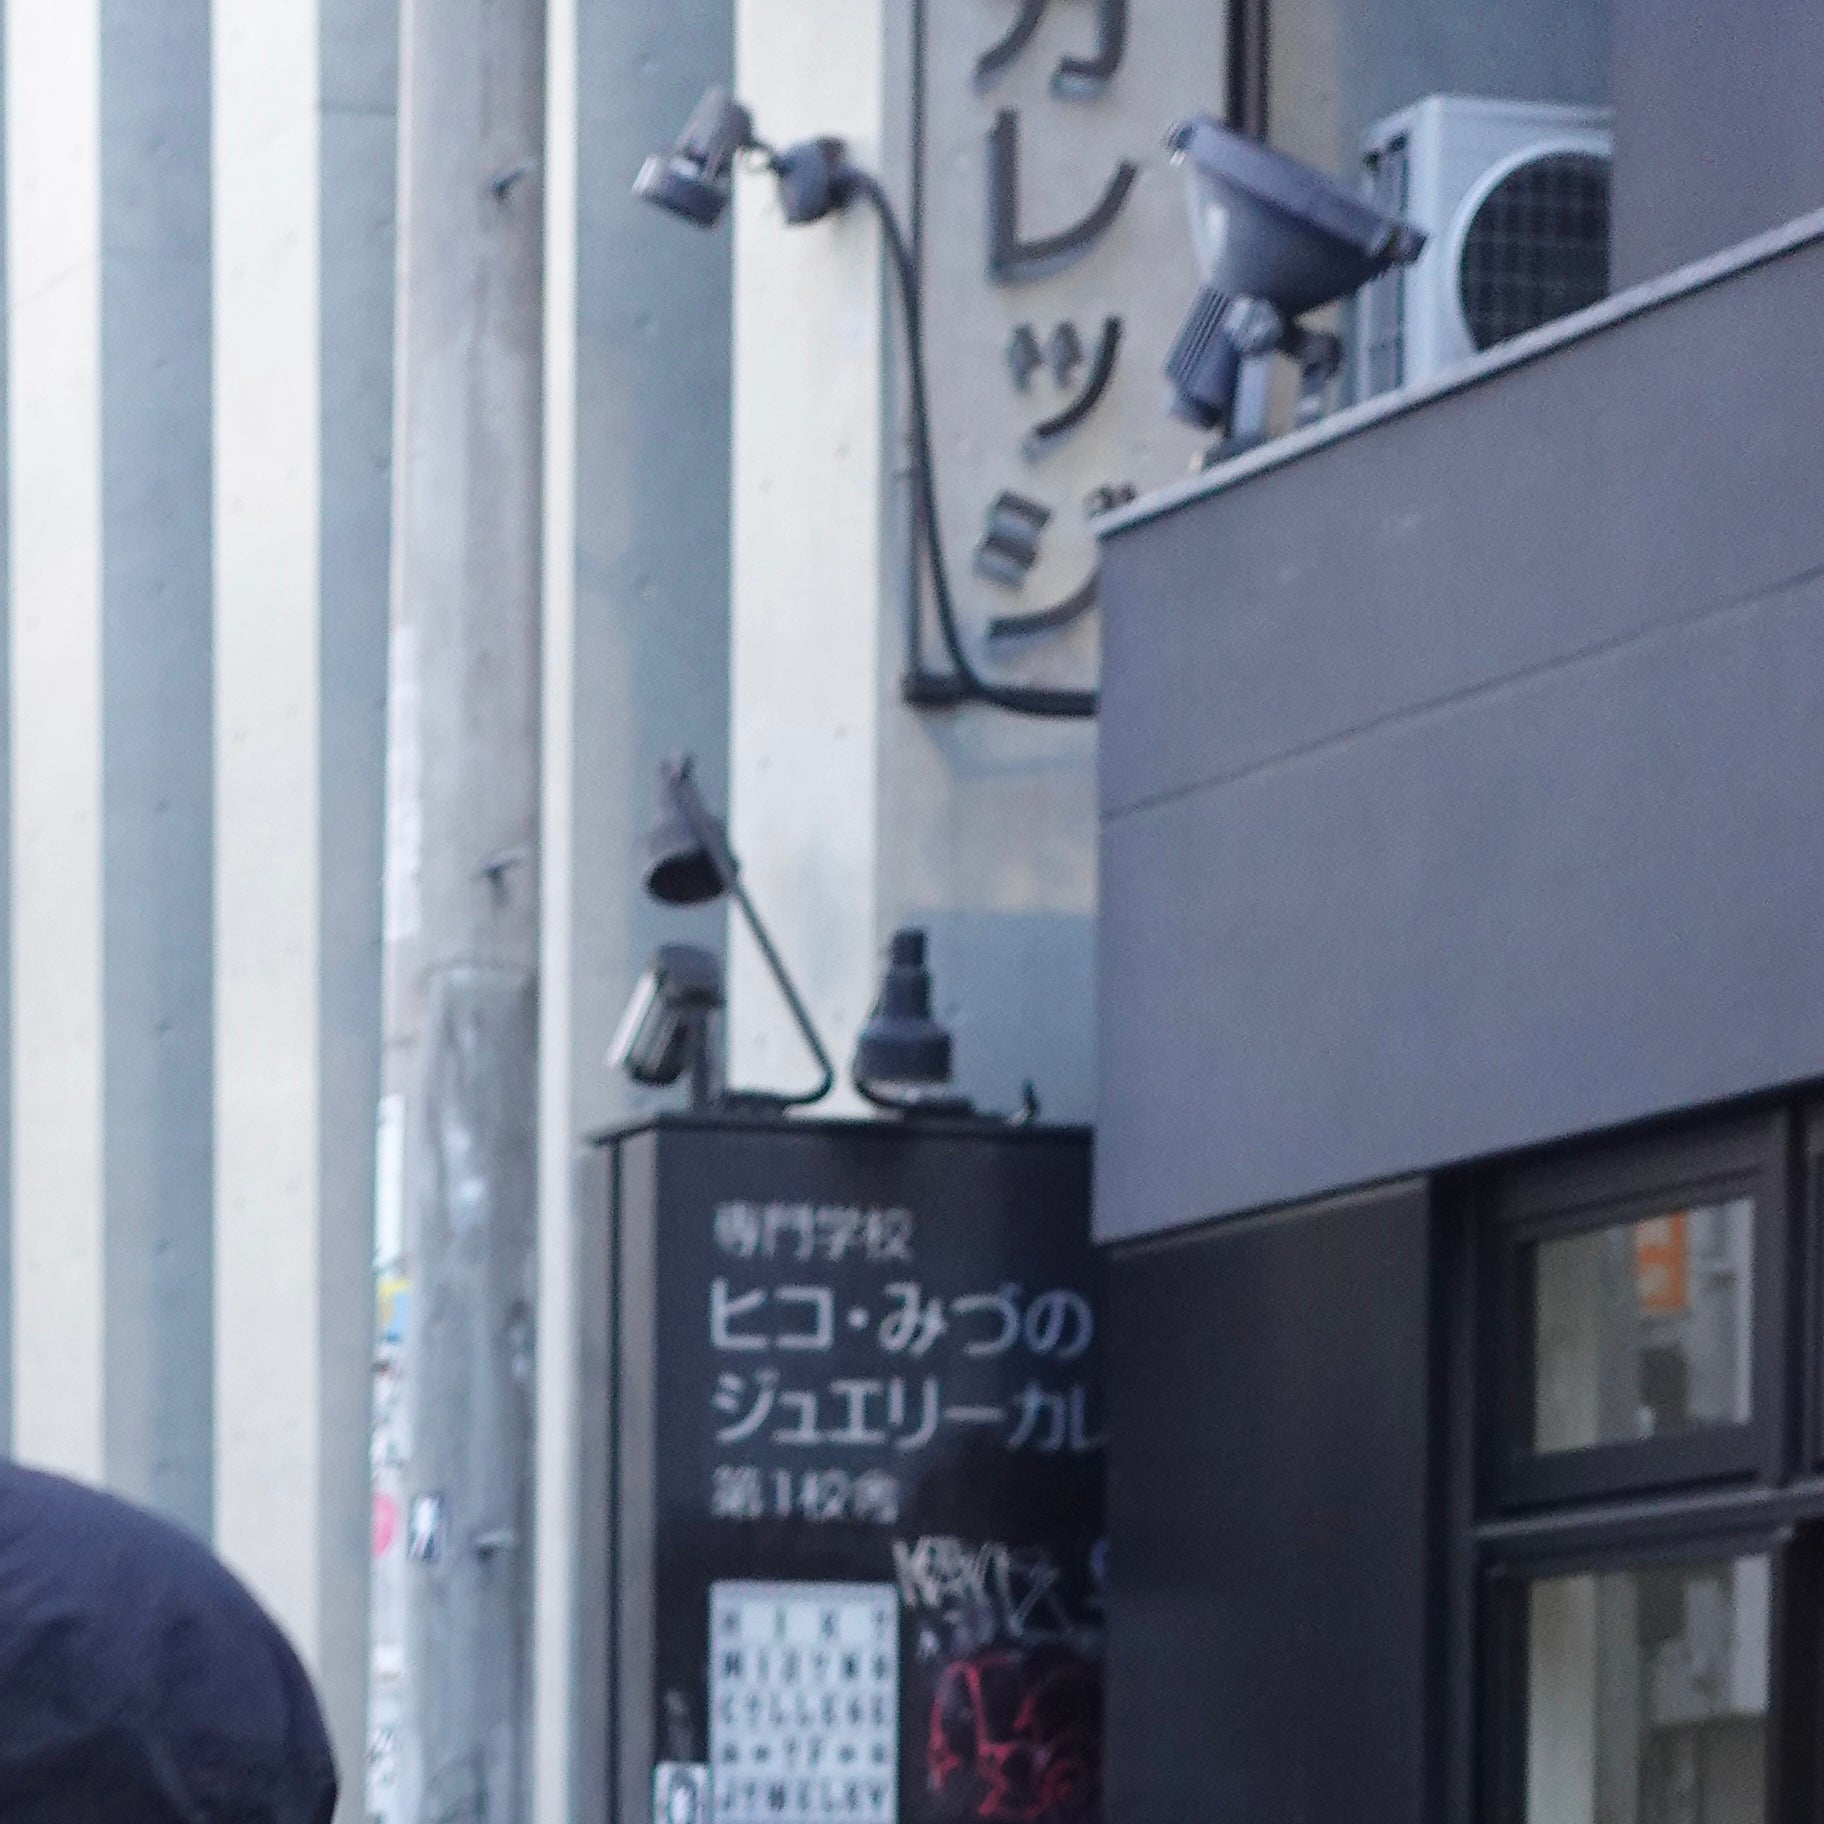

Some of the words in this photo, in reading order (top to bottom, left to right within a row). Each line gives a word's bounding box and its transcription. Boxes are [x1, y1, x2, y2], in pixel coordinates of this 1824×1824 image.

[712, 1201, 914, 1262] 専門学校
[709, 1277, 1095, 1358] ヒコ・みづの
